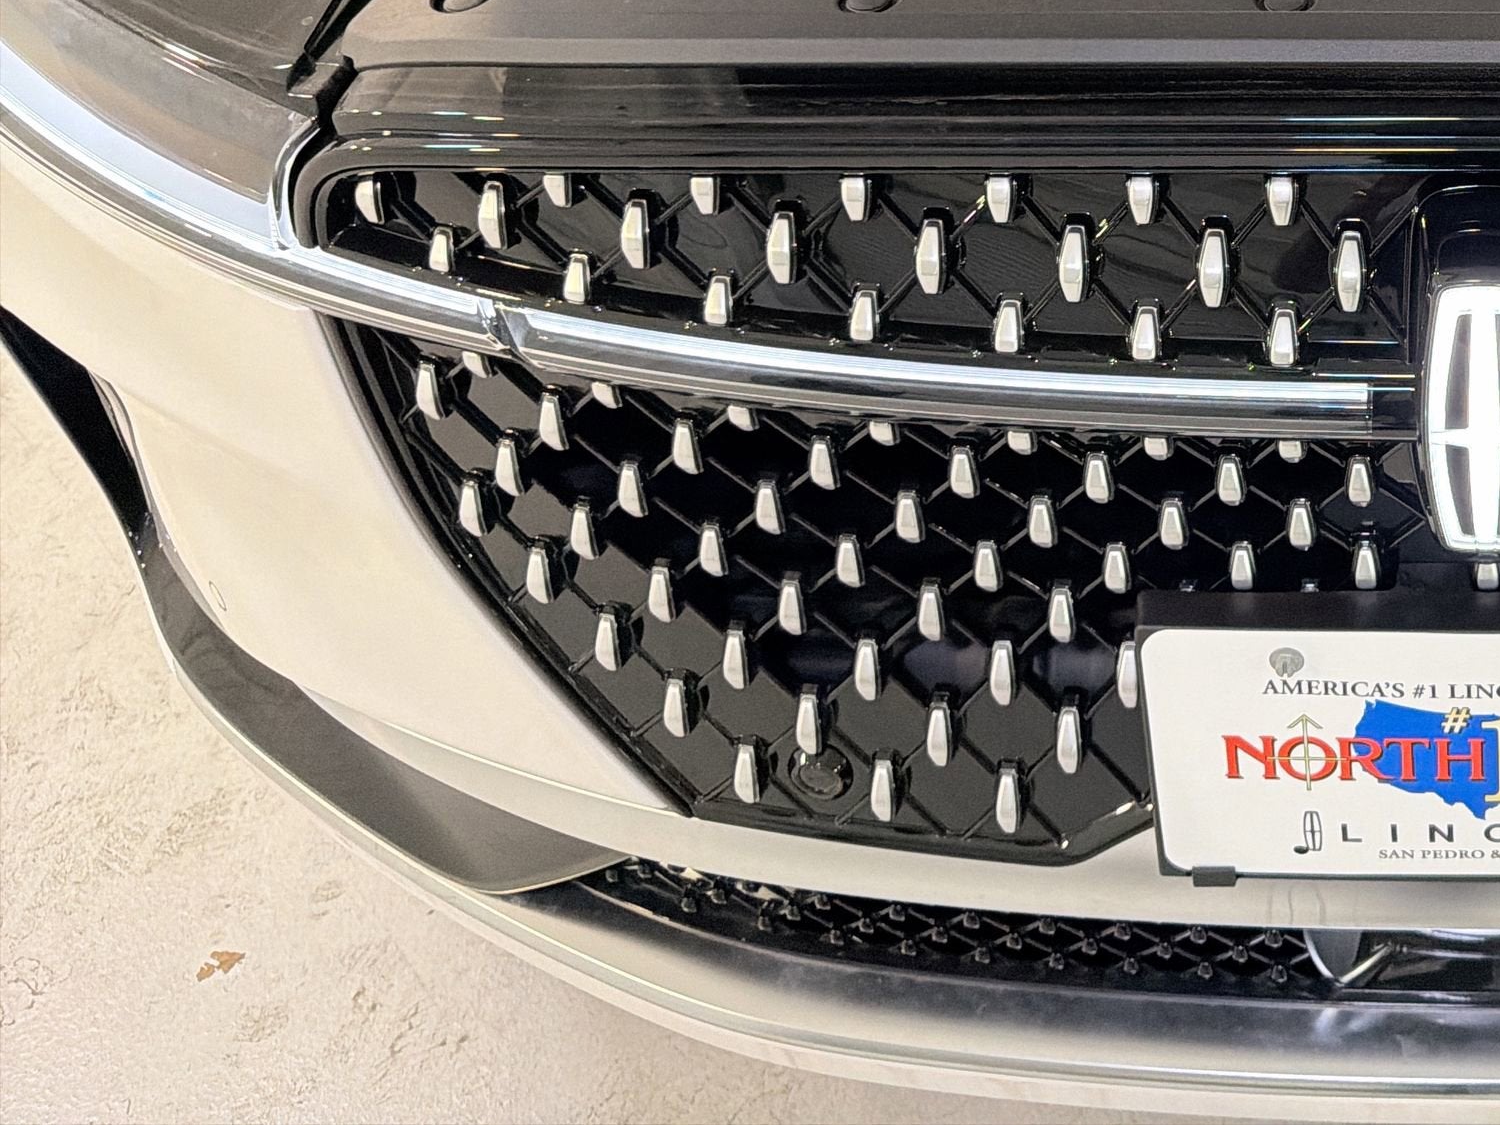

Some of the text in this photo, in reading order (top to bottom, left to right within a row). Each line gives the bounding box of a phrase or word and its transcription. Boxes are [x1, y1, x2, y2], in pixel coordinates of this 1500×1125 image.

[1262, 679, 1405, 698] AMERICA'S
[1412, 683, 1440, 699] #1
[1221, 735, 1486, 782] NORTH
[1378, 849, 1415, 859] SAN
[1421, 849, 1485, 859] PEDRO
